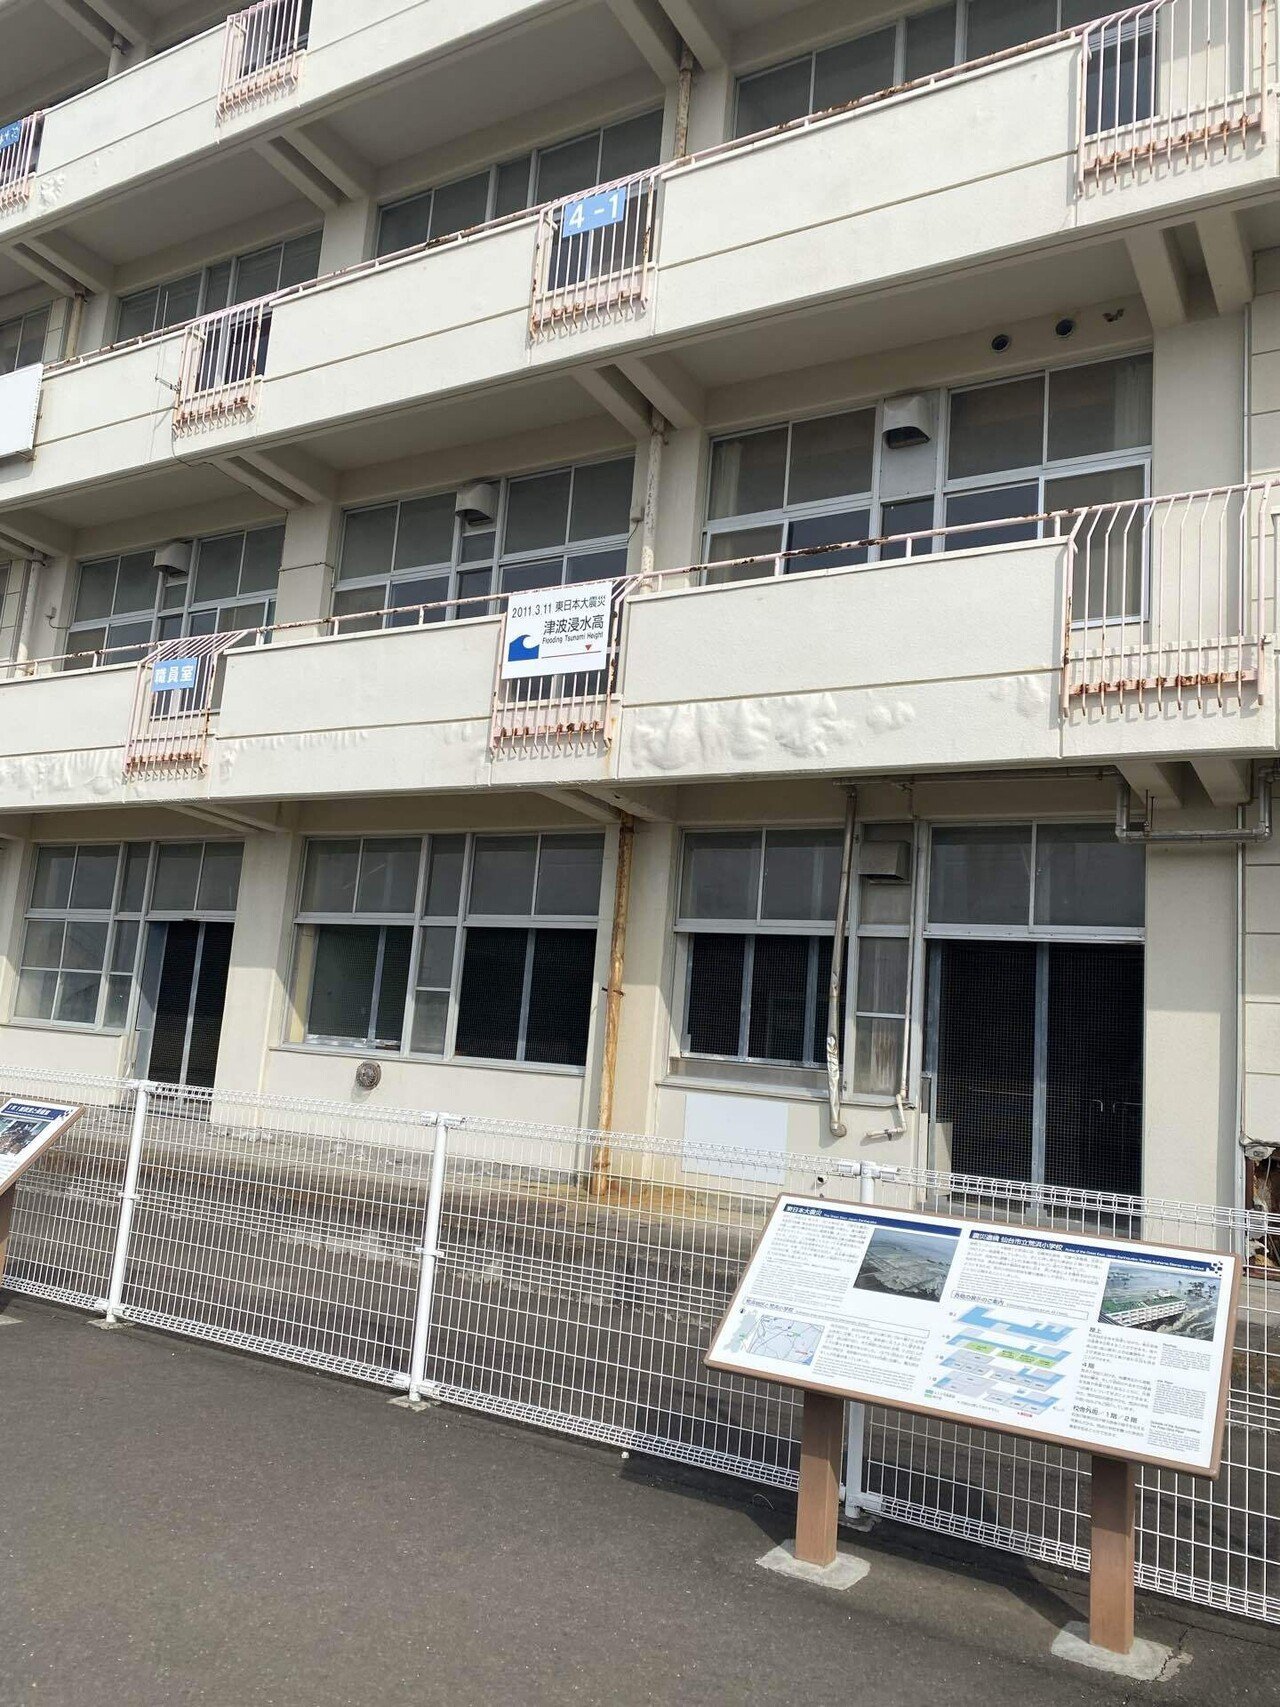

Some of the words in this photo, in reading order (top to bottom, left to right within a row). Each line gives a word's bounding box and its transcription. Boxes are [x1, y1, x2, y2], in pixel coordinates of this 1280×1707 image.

[555, 595, 606, 613] 東日本大震災
[543, 614, 605, 635] 津波浸水高
[542, 636, 563, 645] Flooding
[565, 633, 585, 642] Tsunami
[587, 631, 604, 640] Height
[154, 665, 194, 684] 職員室
